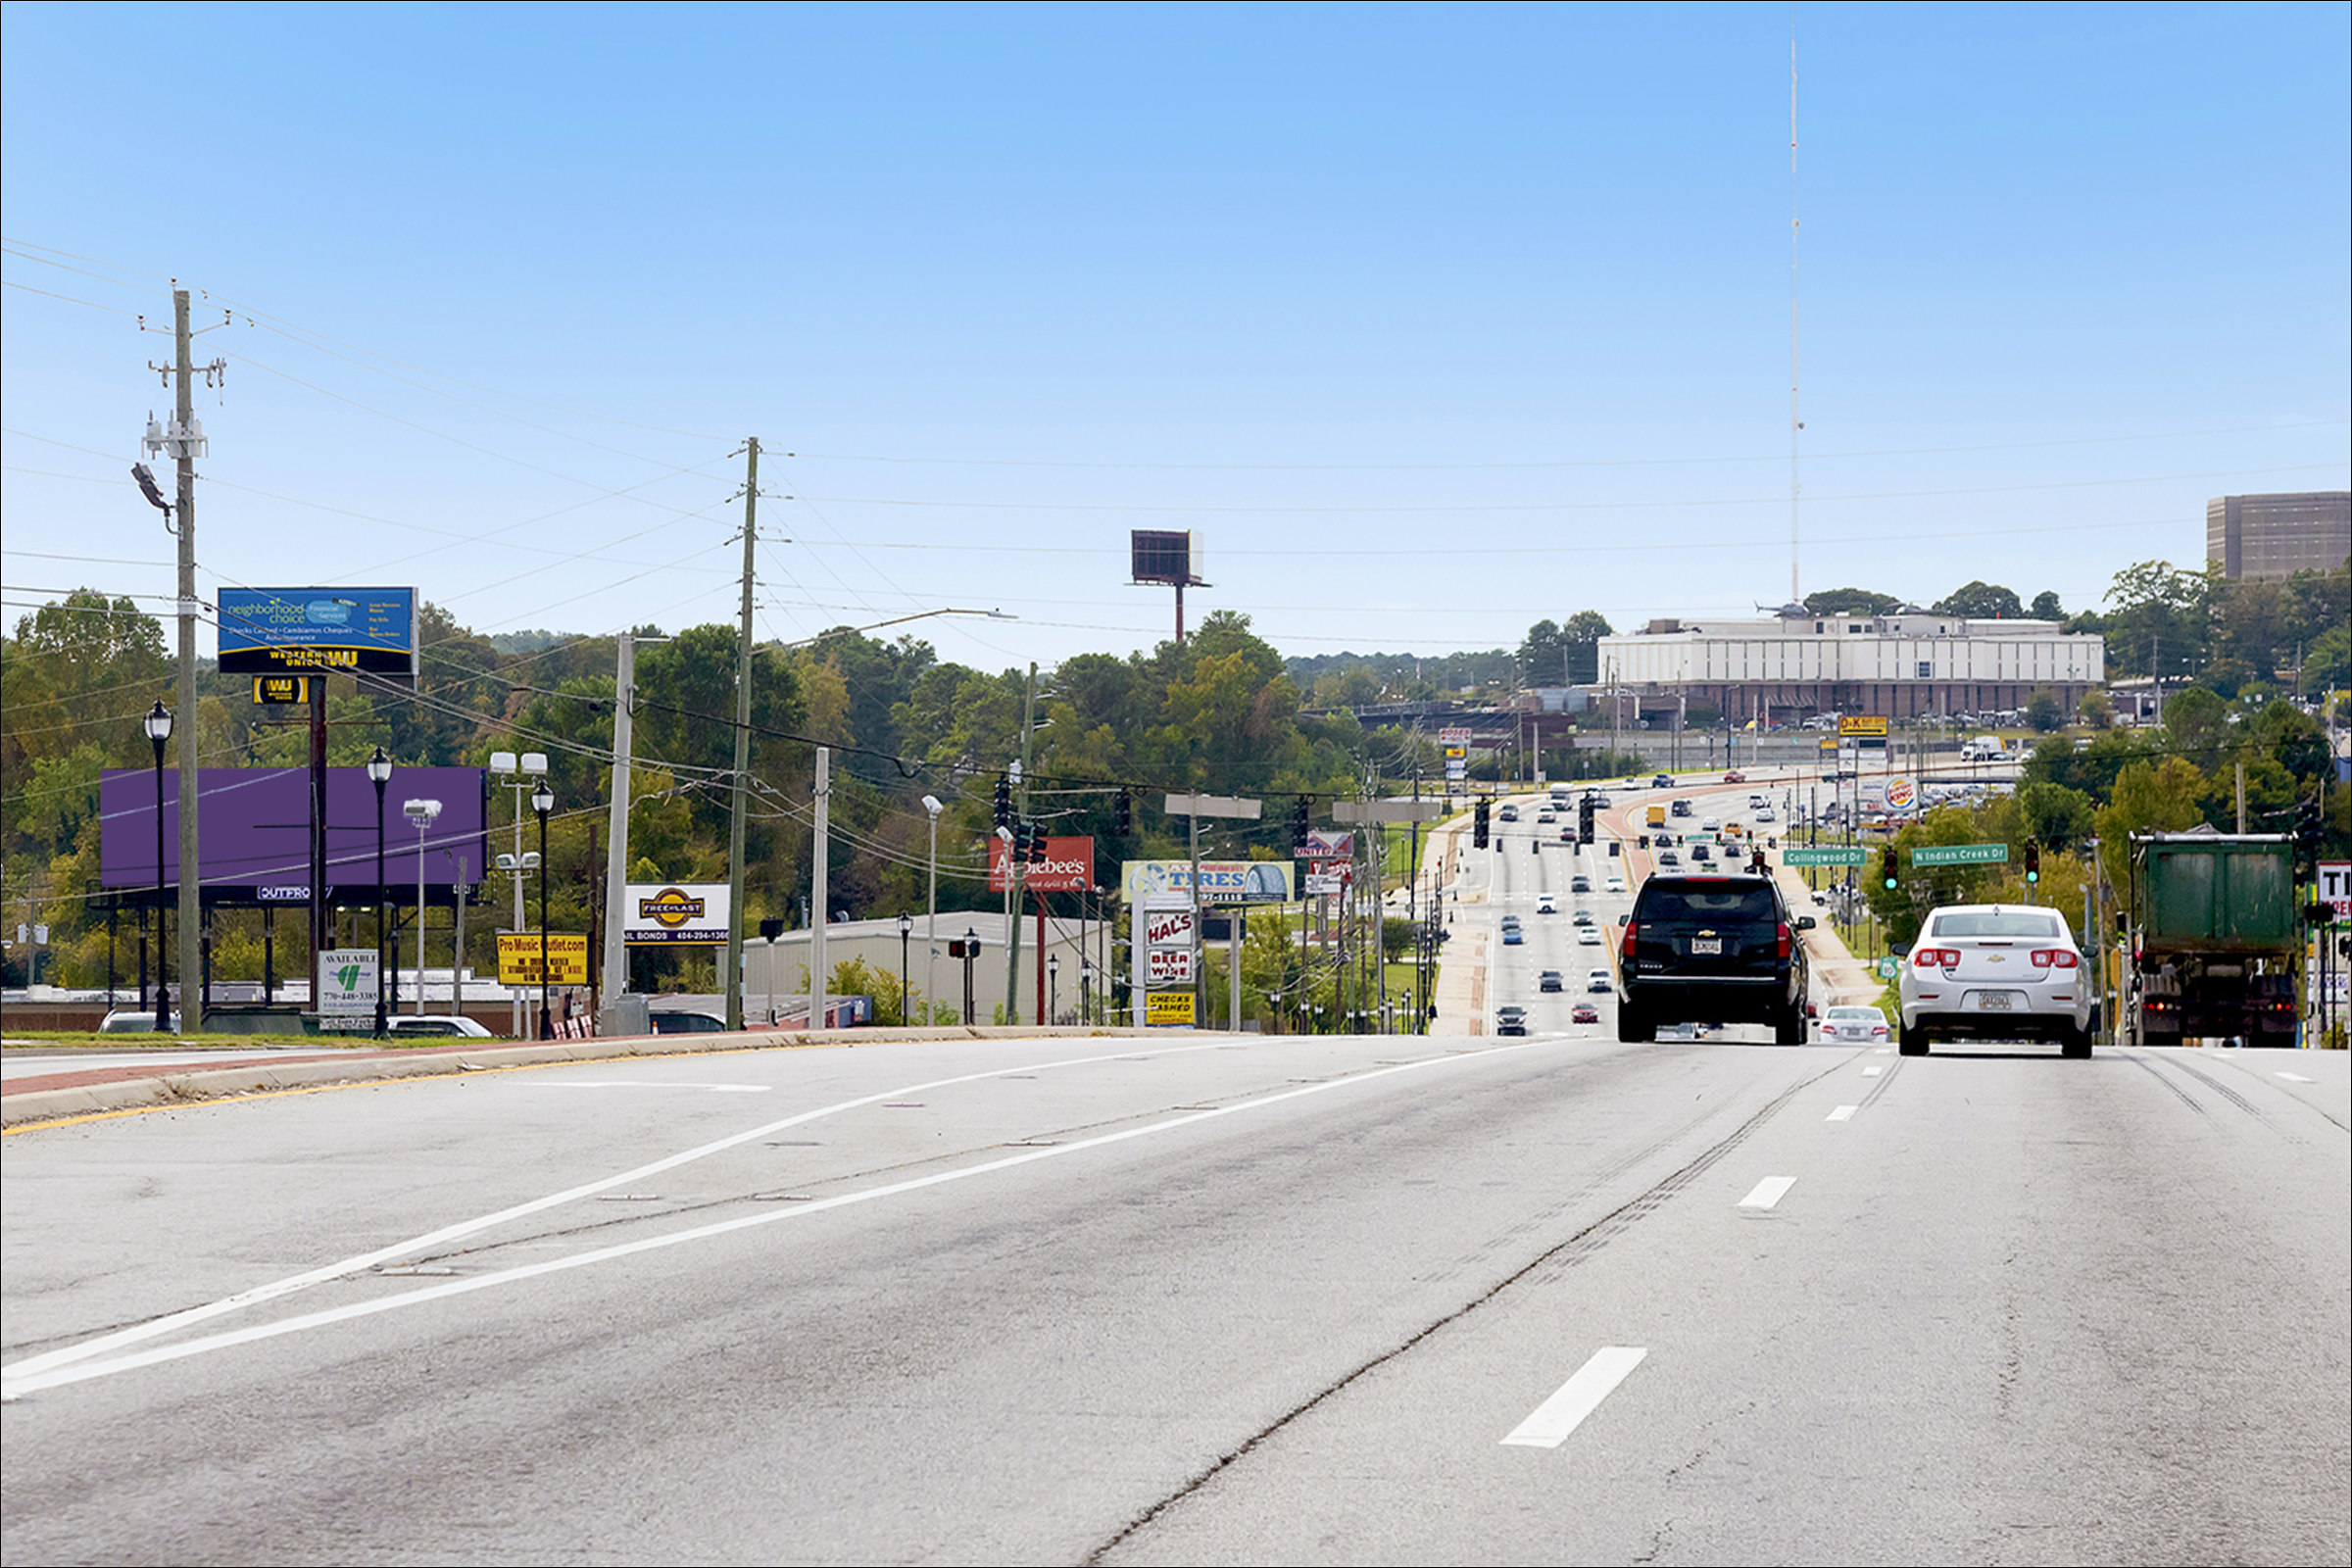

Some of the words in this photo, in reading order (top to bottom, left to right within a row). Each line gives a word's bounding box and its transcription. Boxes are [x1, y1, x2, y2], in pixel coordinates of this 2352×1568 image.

[227, 603, 306, 617] neighborhood
[269, 614, 305, 624] choice
[1889, 790, 1913, 803] KING
[1788, 853, 1847, 863] Collingwood
[1849, 853, 1861, 861] Dr
[1926, 852, 1957, 860] Indian
[1960, 849, 1988, 859] Creek
[1992, 848, 2003, 858] Dr
[994, 854, 1085, 877] Aplebee's
[261, 887, 328, 899] OUTFRO
[636, 931, 668, 940] BONDS
[1148, 914, 1192, 945] HAL'S
[499, 938, 513, 952] Pro
[514, 938, 539, 952] Music
[541, 938, 585, 952] utlet.com
[324, 955, 377, 963] AVAILABLE
[1152, 955, 1188, 963] BEER
[1152, 967, 1187, 976] WINE
